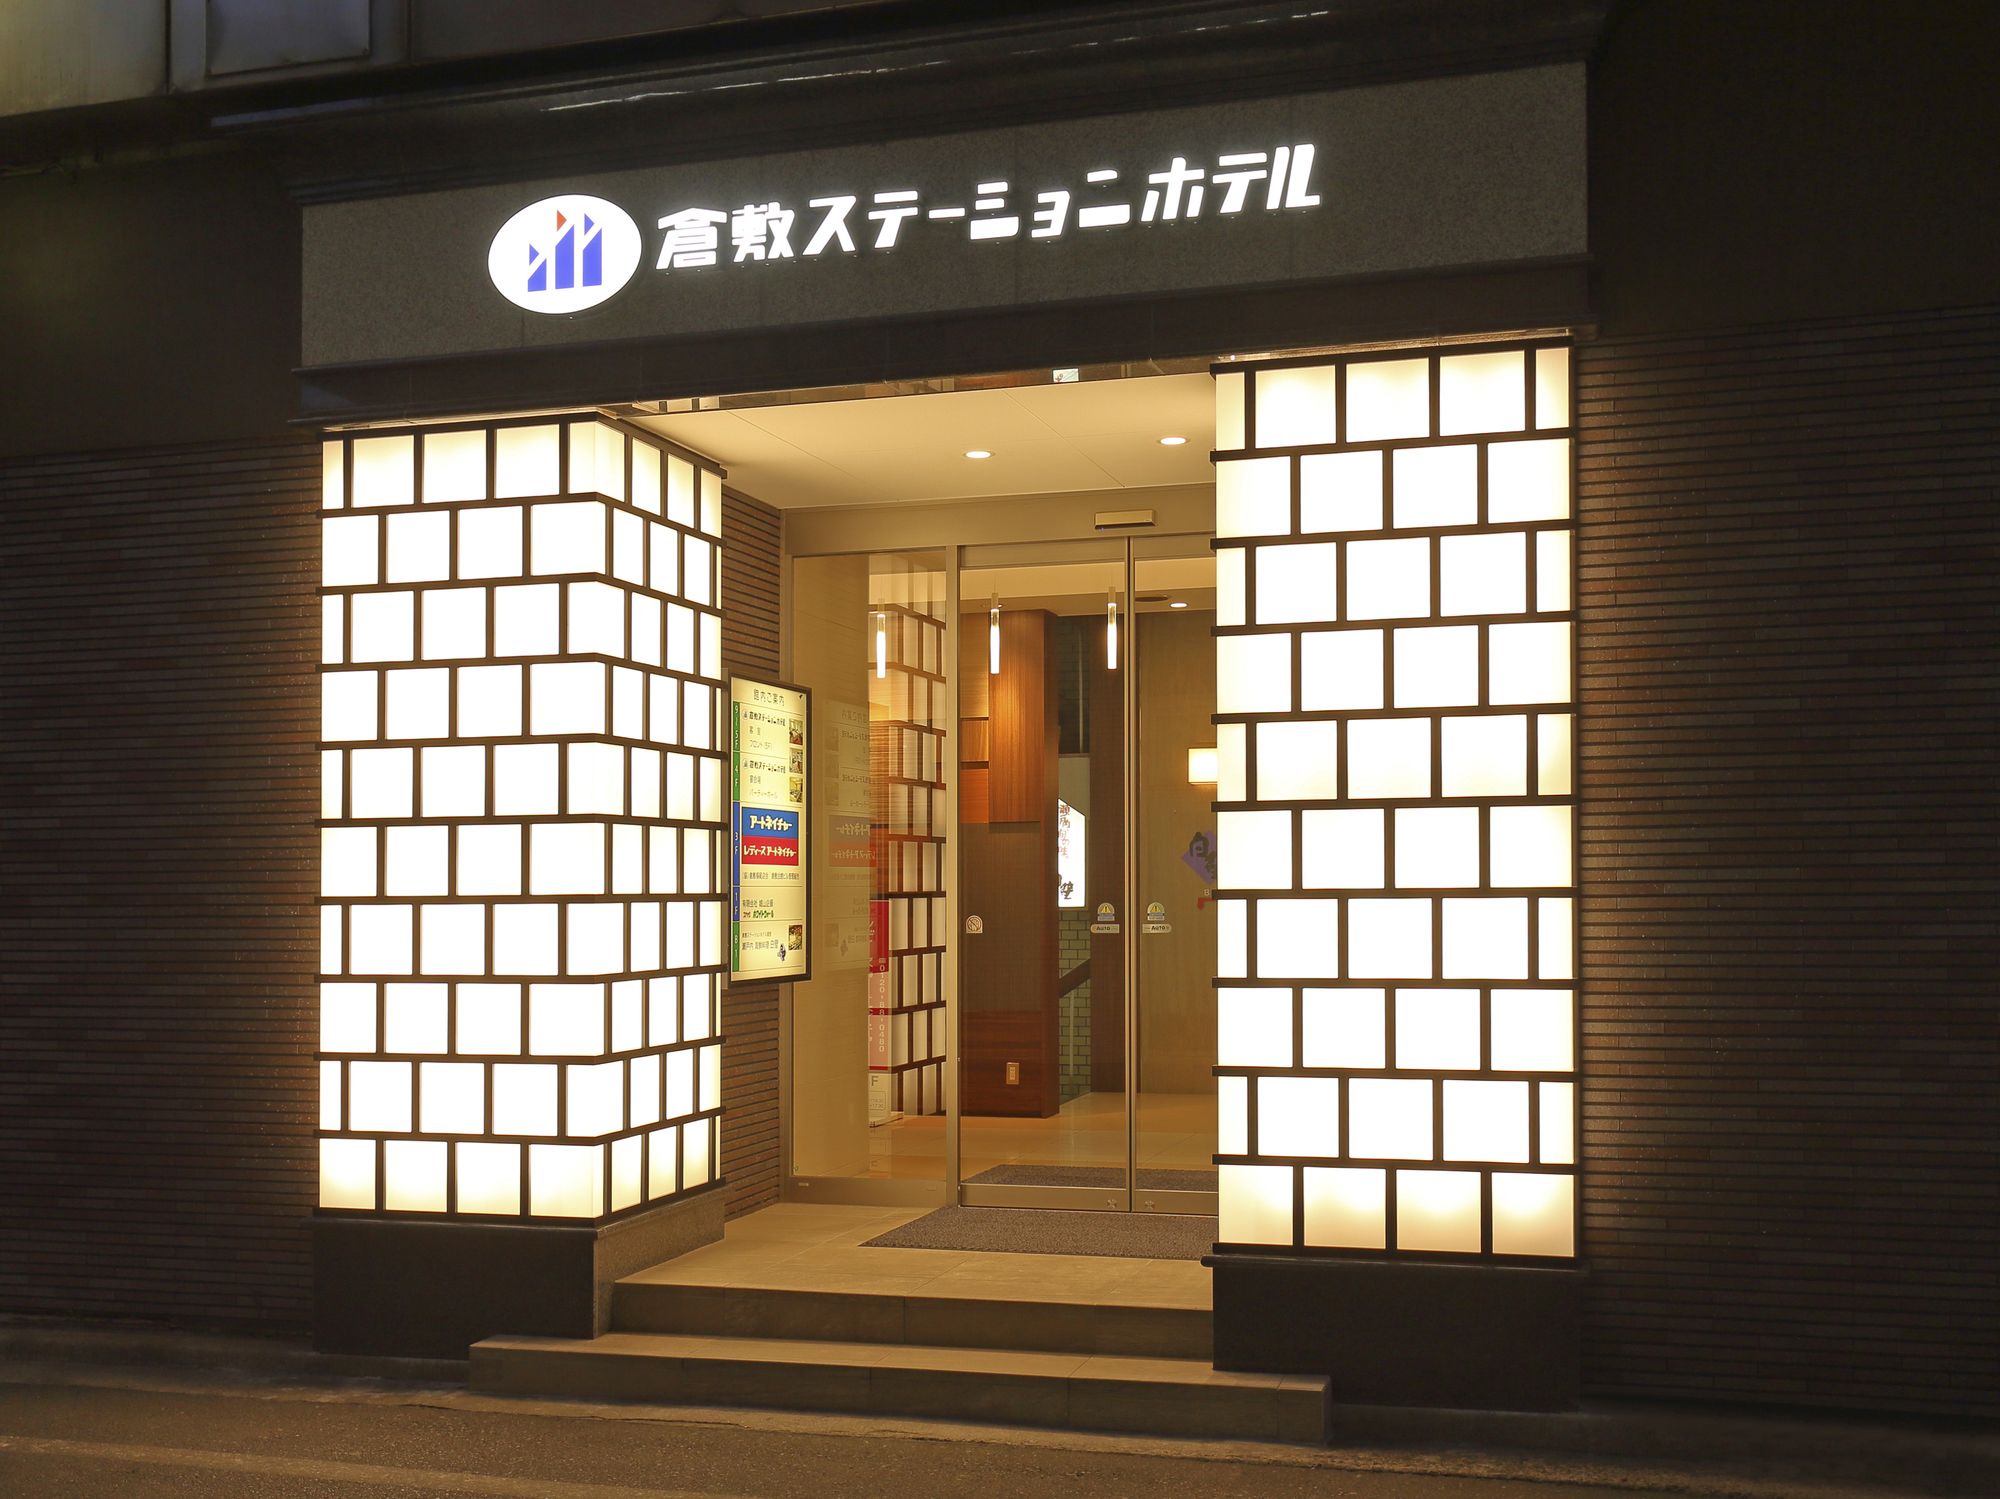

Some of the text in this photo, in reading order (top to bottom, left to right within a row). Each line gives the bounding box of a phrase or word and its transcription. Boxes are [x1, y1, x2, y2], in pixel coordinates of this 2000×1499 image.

[655, 143, 1322, 271] 倉敷ステーションホテル
[750, 815, 793, 831] アートネイチャー
